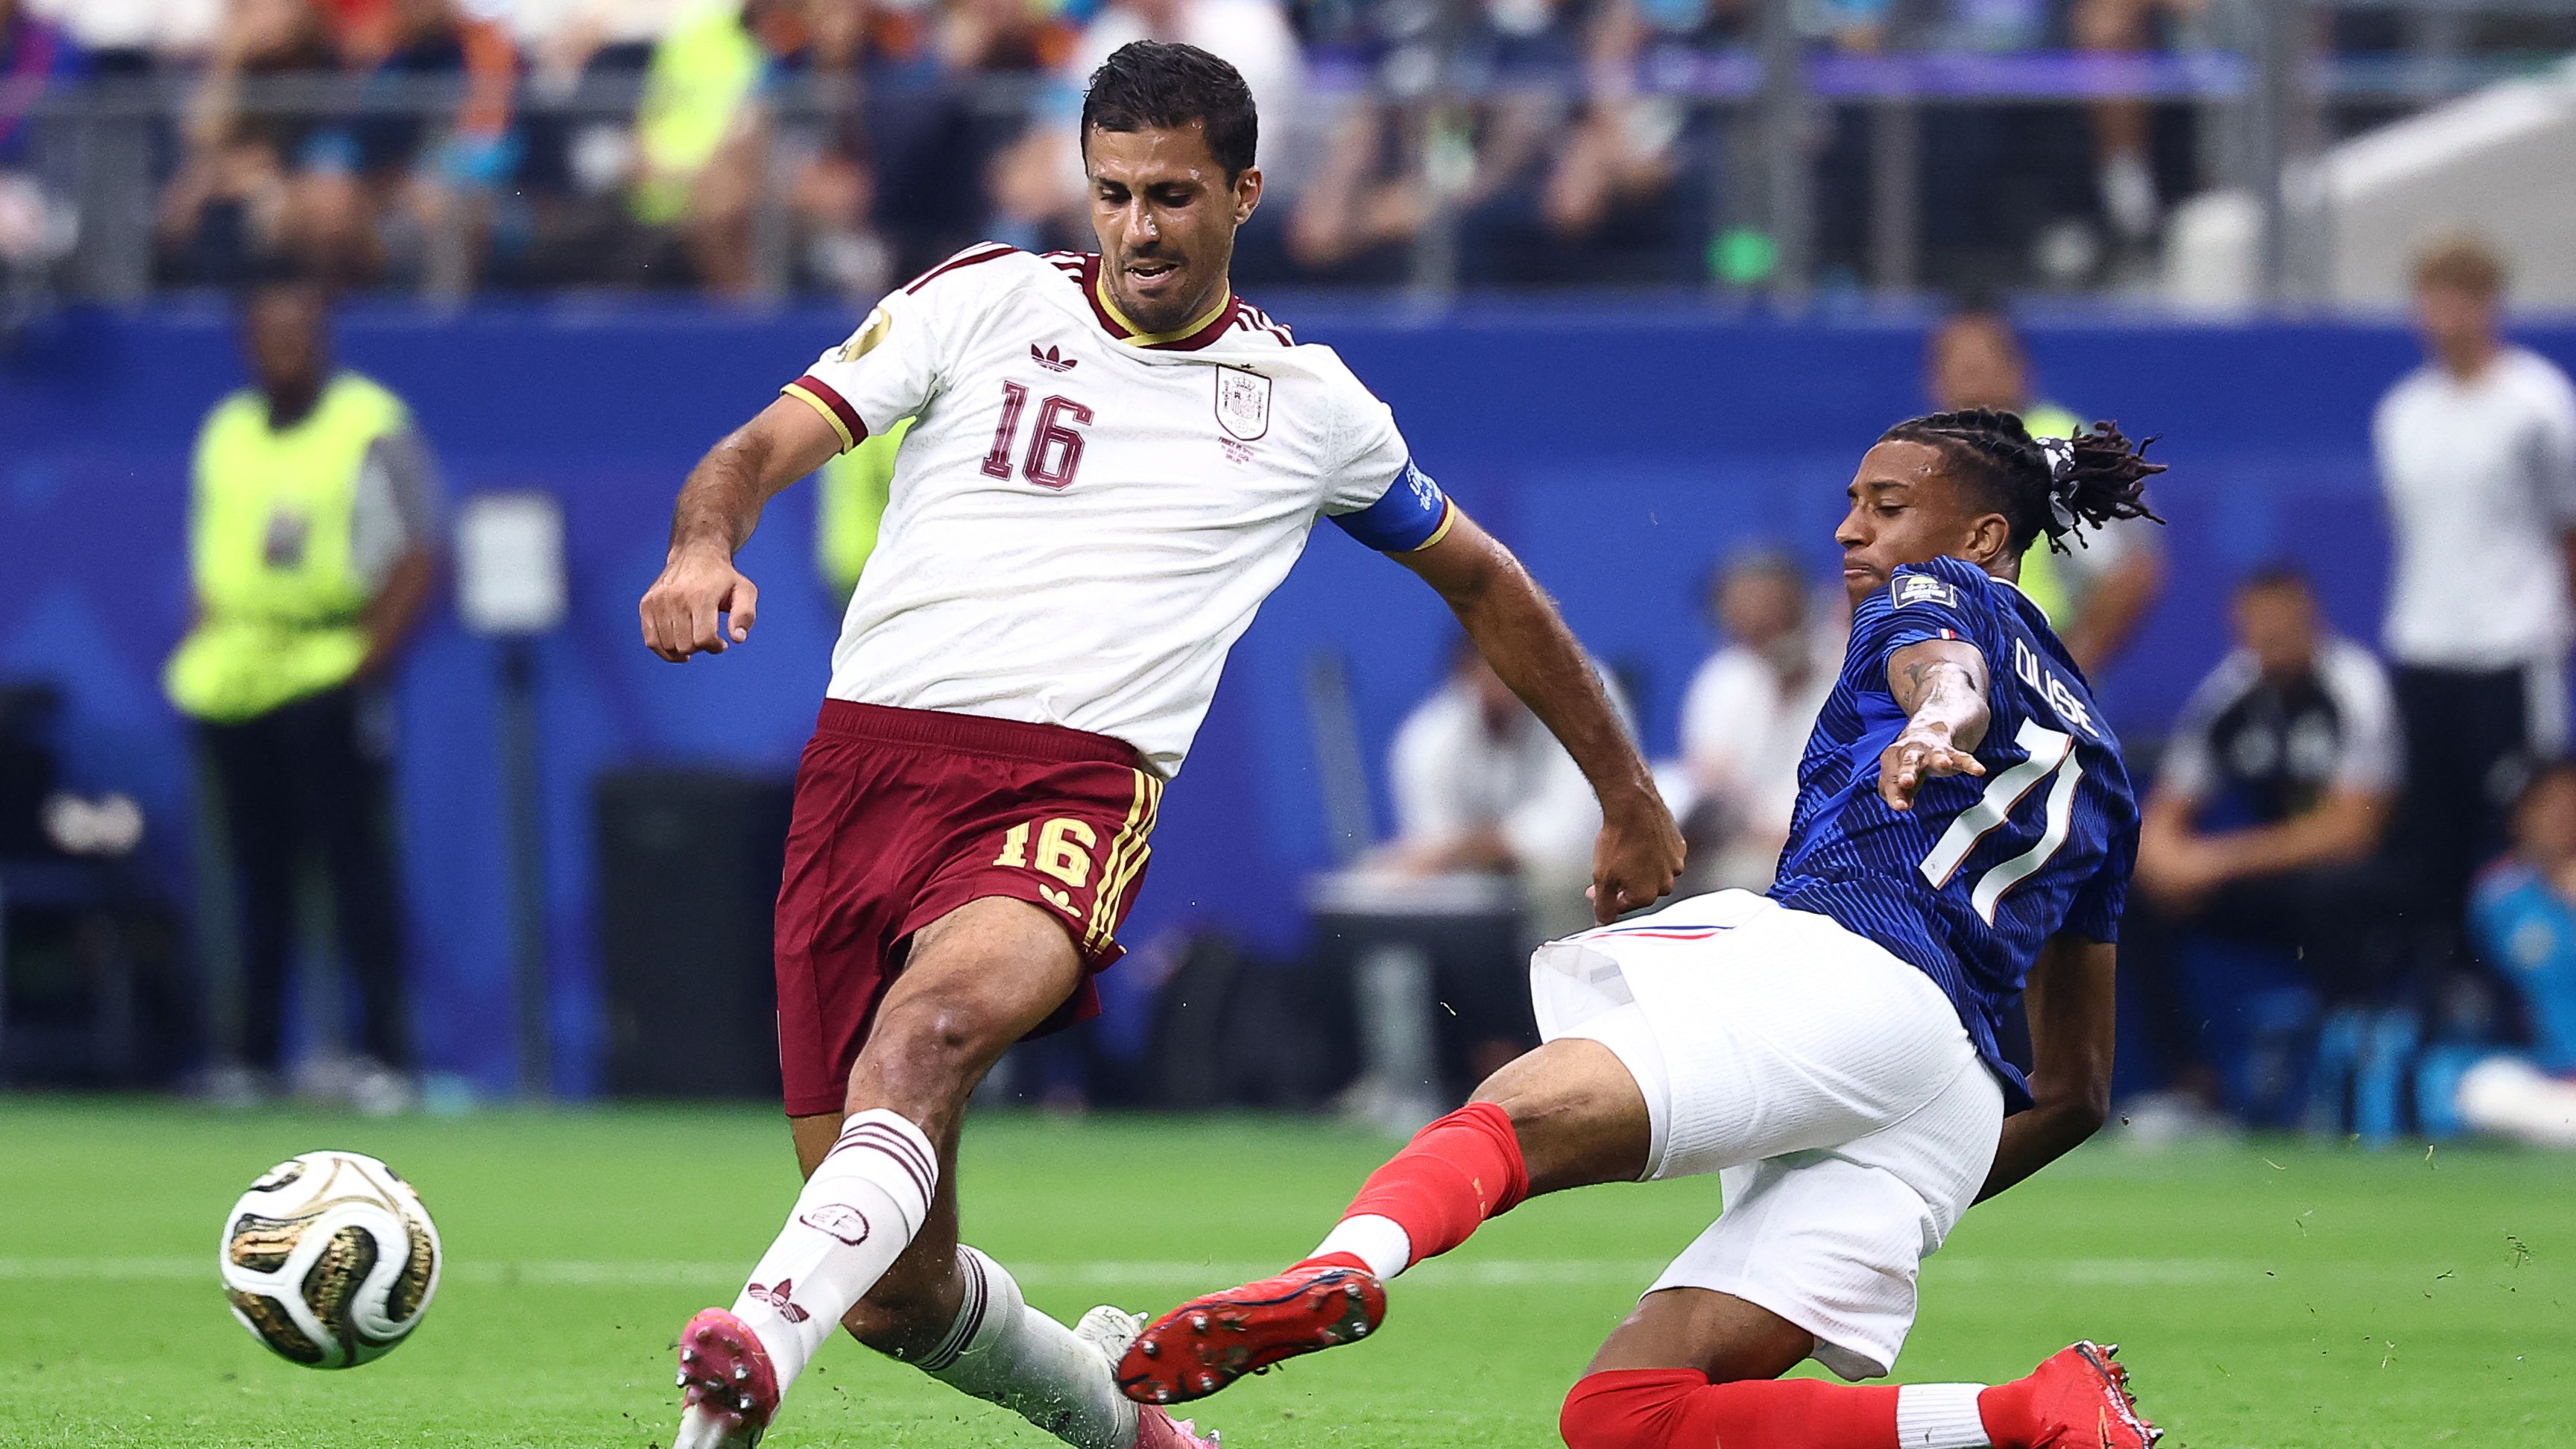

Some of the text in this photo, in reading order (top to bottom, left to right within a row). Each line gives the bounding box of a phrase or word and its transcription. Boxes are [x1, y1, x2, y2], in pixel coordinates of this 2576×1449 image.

[980, 380, 1095, 491] 16
[2015, 637, 2100, 738] OLISE
[992, 817, 1098, 888] 16
[1919, 716, 2086, 929] 11
